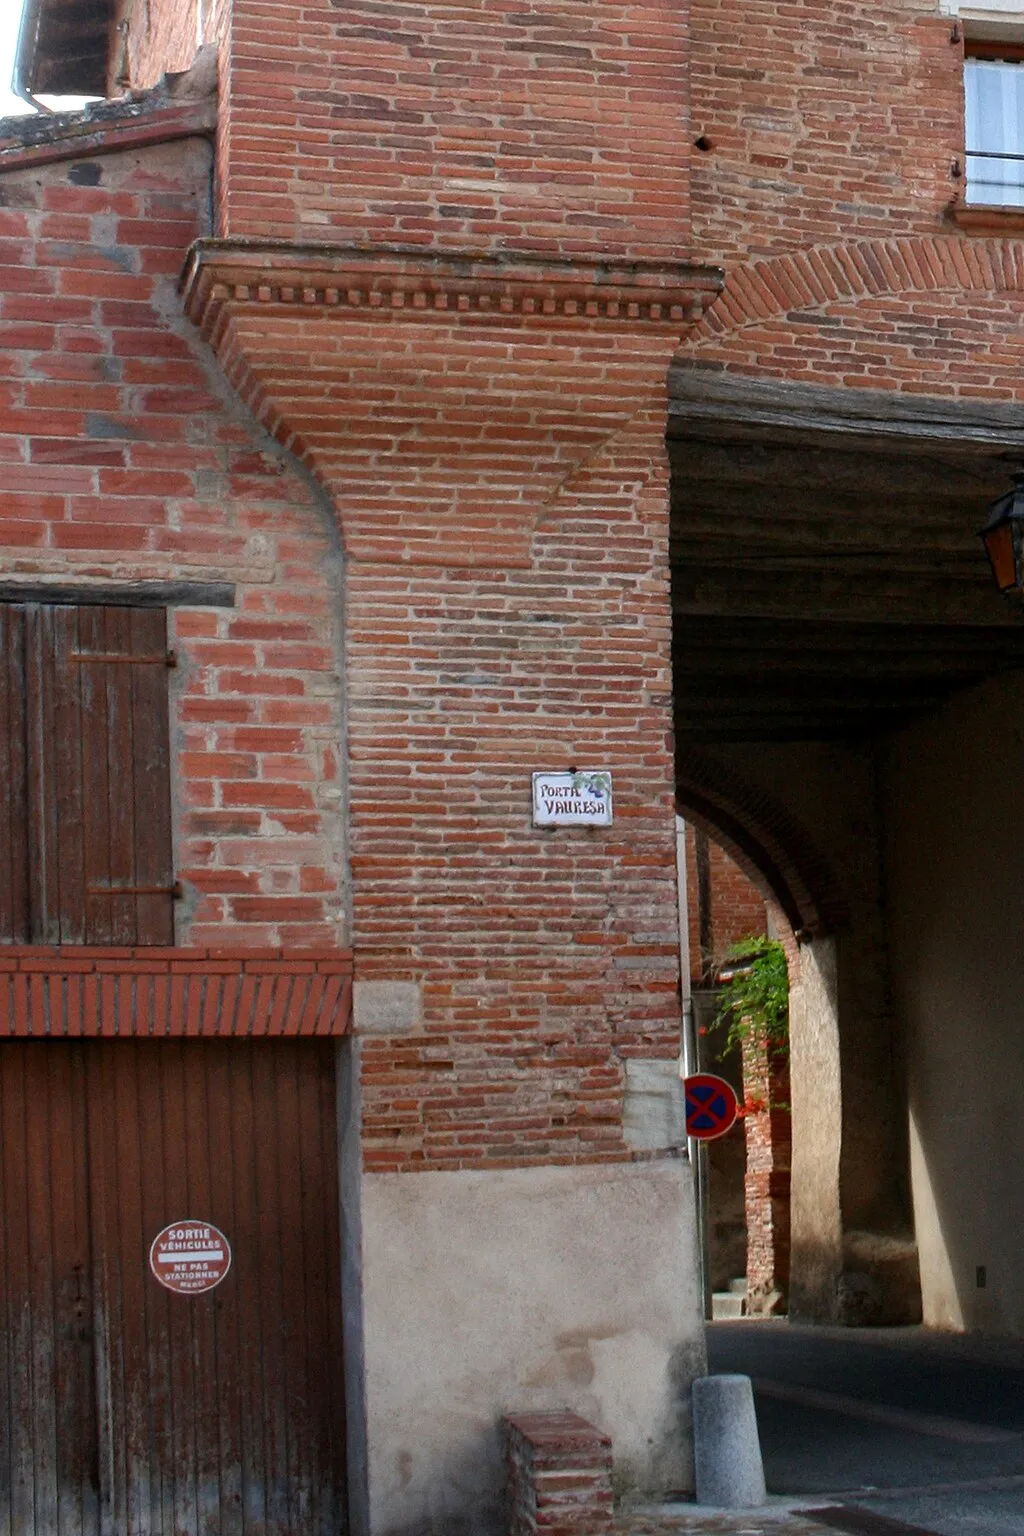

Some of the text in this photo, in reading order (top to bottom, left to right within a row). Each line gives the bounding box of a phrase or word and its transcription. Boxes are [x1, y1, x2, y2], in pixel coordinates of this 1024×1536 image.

[541, 784, 581, 797] PORTA
[544, 800, 605, 815] VAURESA
[168, 1228, 210, 1240] SORTIE
[174, 1262, 208, 1272] NE PAS
[164, 1270, 219, 1281] STATIONNER
